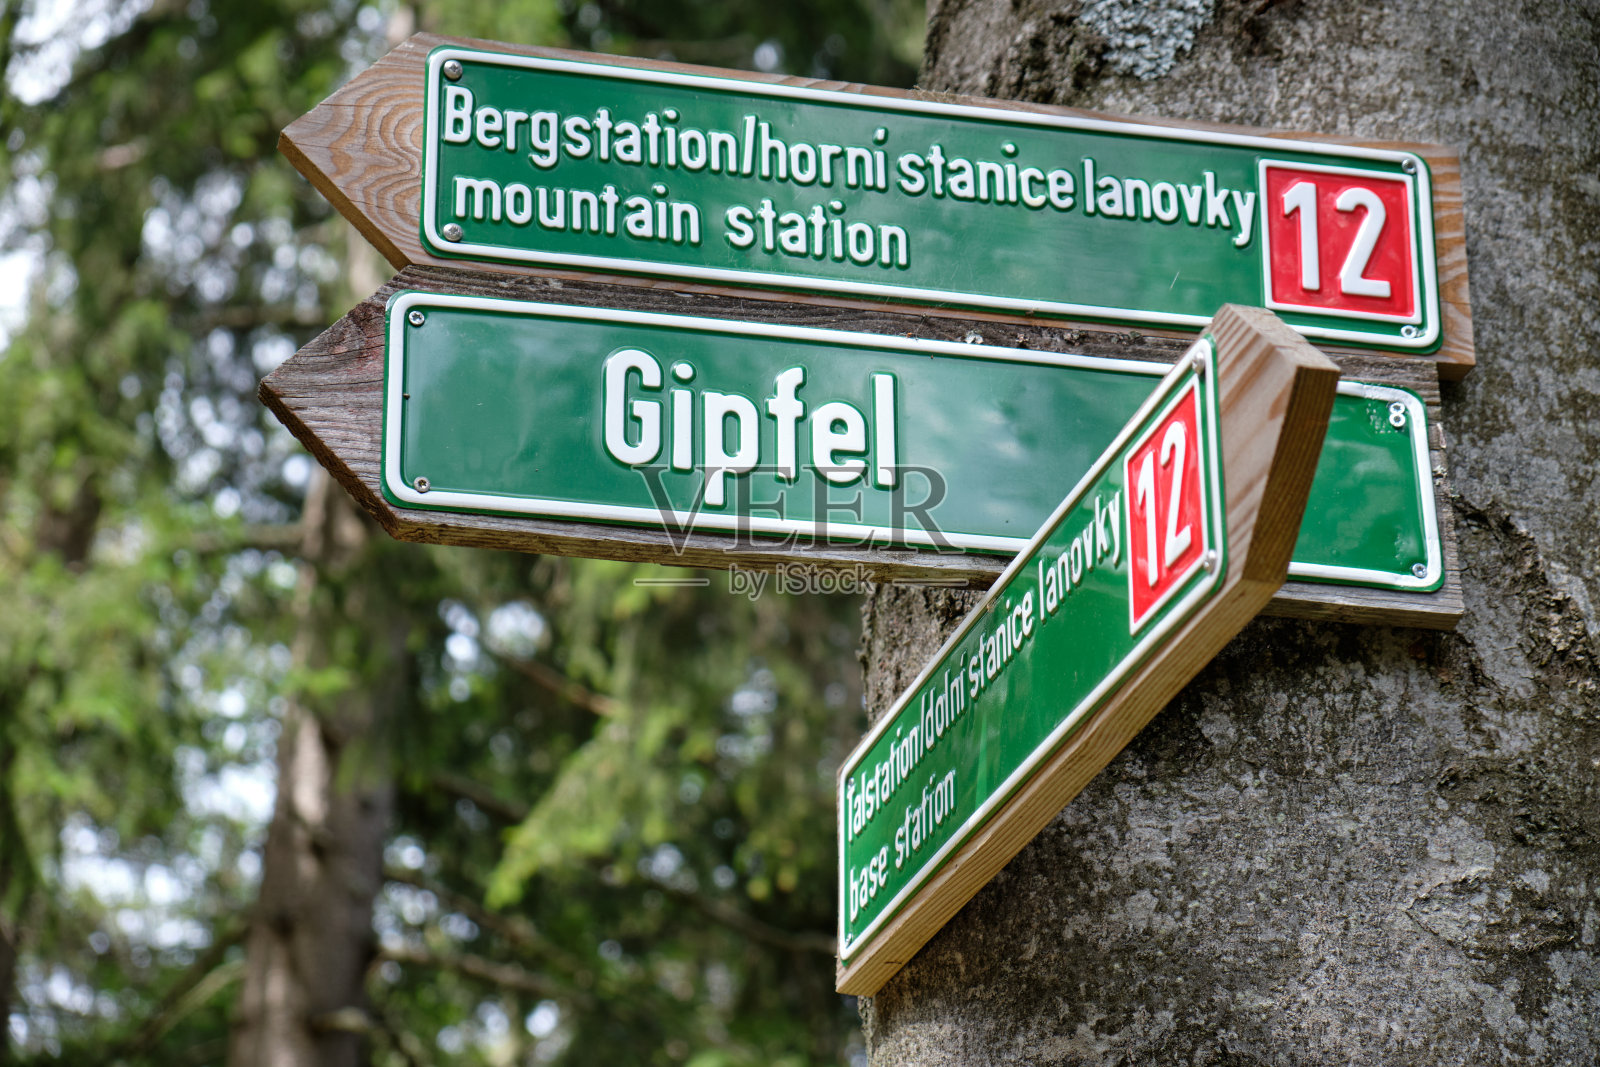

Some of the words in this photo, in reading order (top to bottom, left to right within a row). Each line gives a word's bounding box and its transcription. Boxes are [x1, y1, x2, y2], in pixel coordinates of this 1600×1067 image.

[453, 176, 701, 244] mountain
[724, 199, 909, 267] station
[898, 143, 1076, 210] stanice
[1082, 158, 1256, 248] lanovky
[1283, 181, 1393, 299] 12
[604, 348, 898, 506] Gipfel
[1137, 421, 1192, 588] 12
[967, 589, 1035, 699] stanice
[1038, 488, 1122, 624] lanovky
[849, 845, 888, 923] base
[894, 767, 957, 869] station
